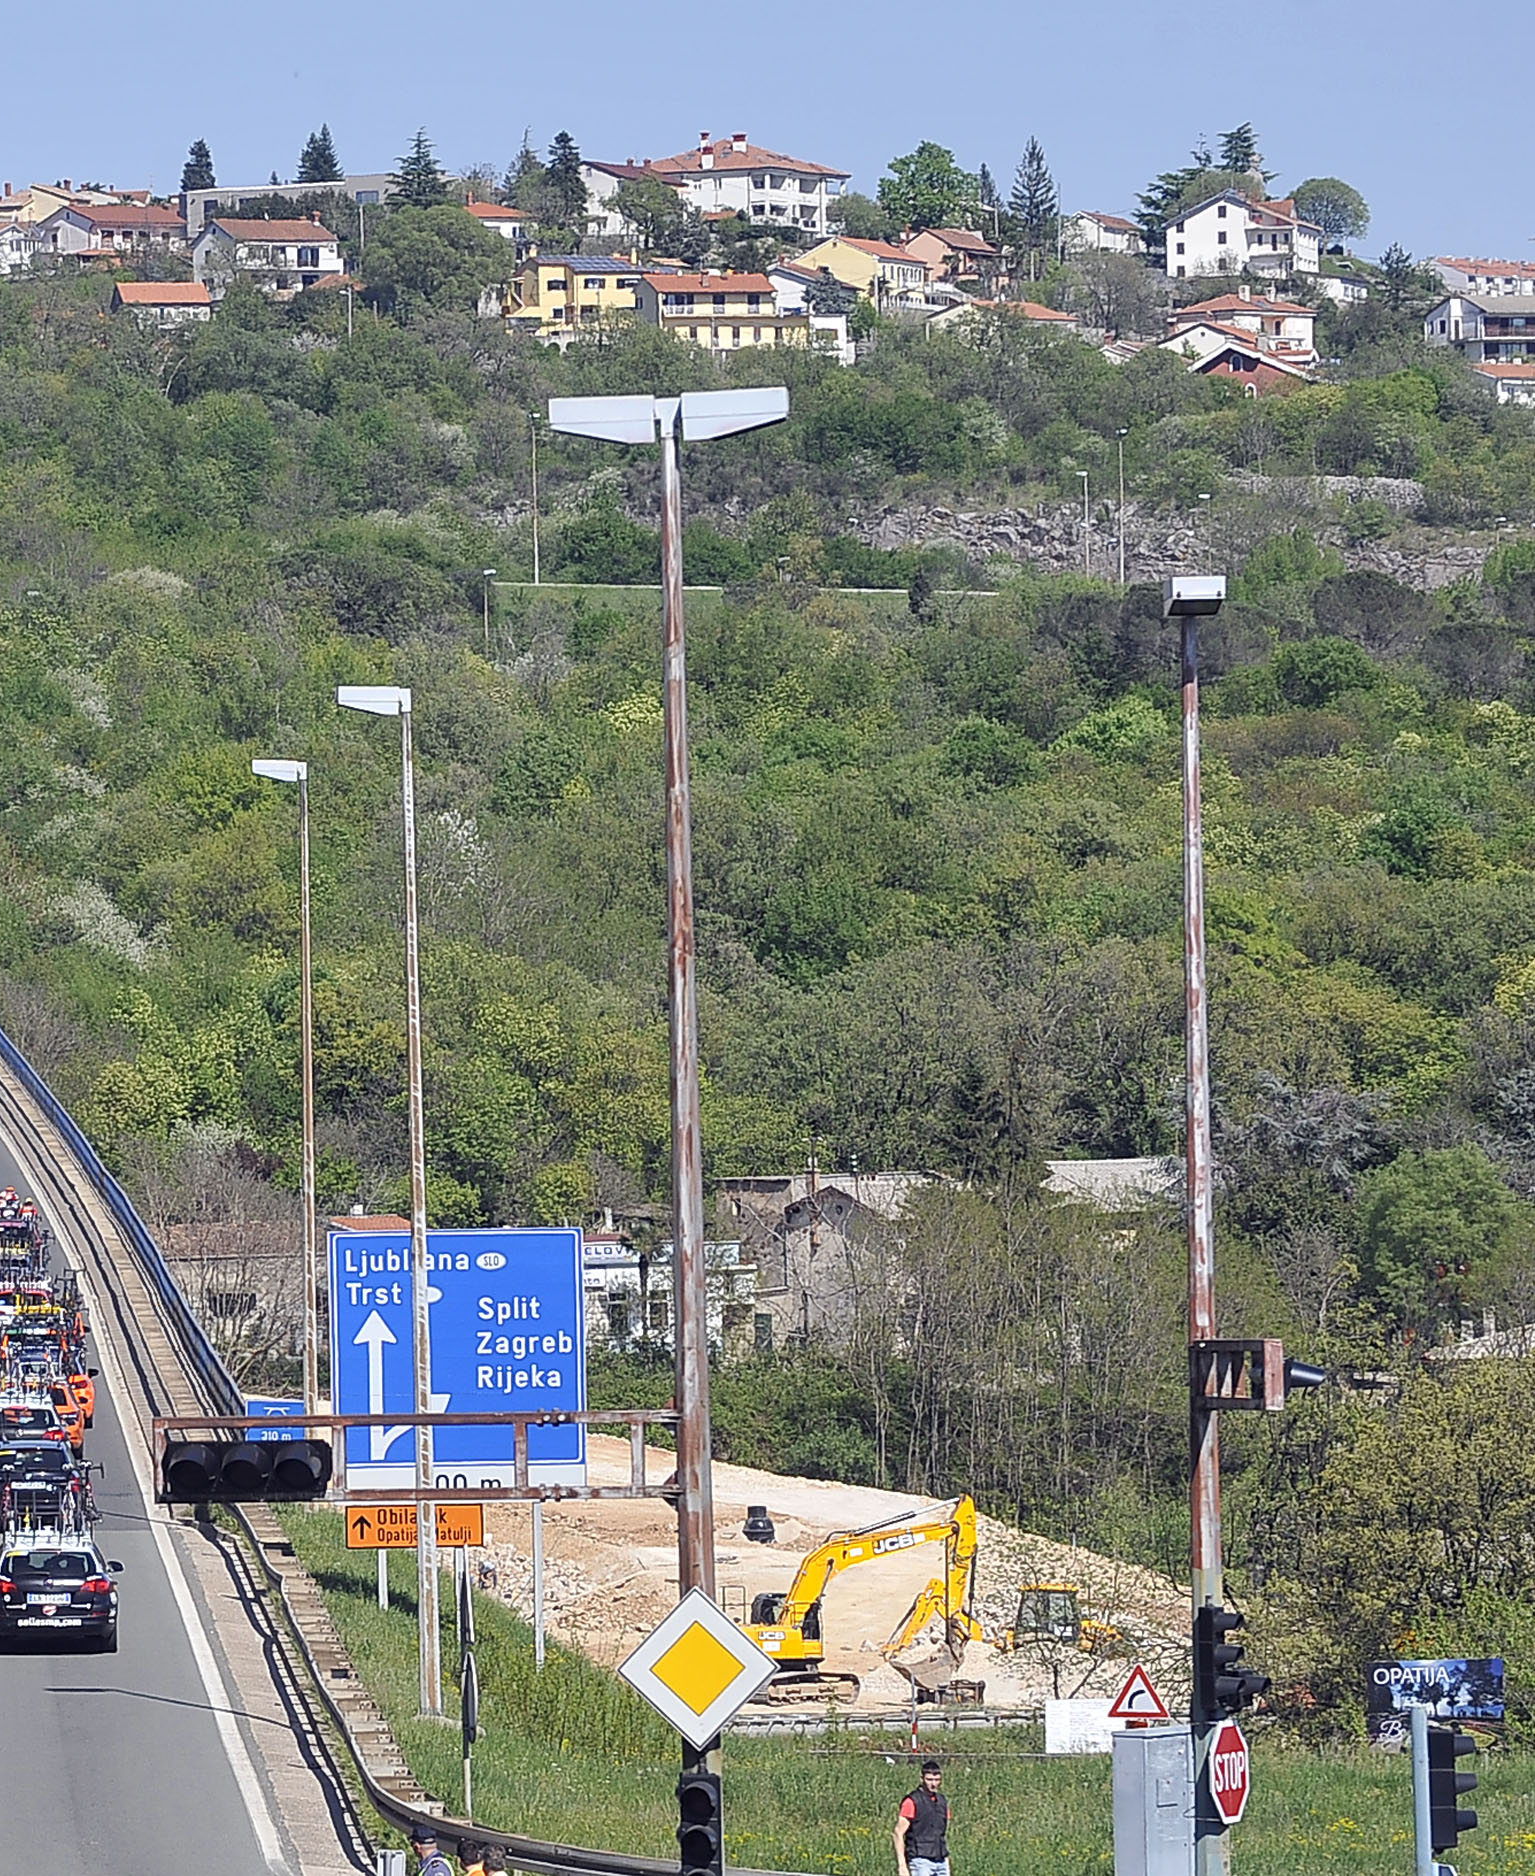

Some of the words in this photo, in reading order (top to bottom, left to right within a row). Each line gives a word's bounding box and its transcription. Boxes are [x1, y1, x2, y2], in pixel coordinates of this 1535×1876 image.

[344, 1249, 470, 1278] Ljublana
[483, 1255, 500, 1267] SLO
[345, 1282, 403, 1306] Trst
[477, 1296, 541, 1326] Split
[476, 1330, 573, 1360] Zagreb
[477, 1363, 562, 1395] Rijeka
[281, 1433, 292, 1441] m
[435, 1474, 468, 1489] 00
[377, 1508, 448, 1526] Obilak
[435, 1526, 472, 1546] atulji
[874, 1533, 915, 1555] JCB
[758, 1631, 786, 1641] JCB
[1373, 1666, 1450, 1687] OPATIJA
[1214, 1750, 1245, 1793] STOP
